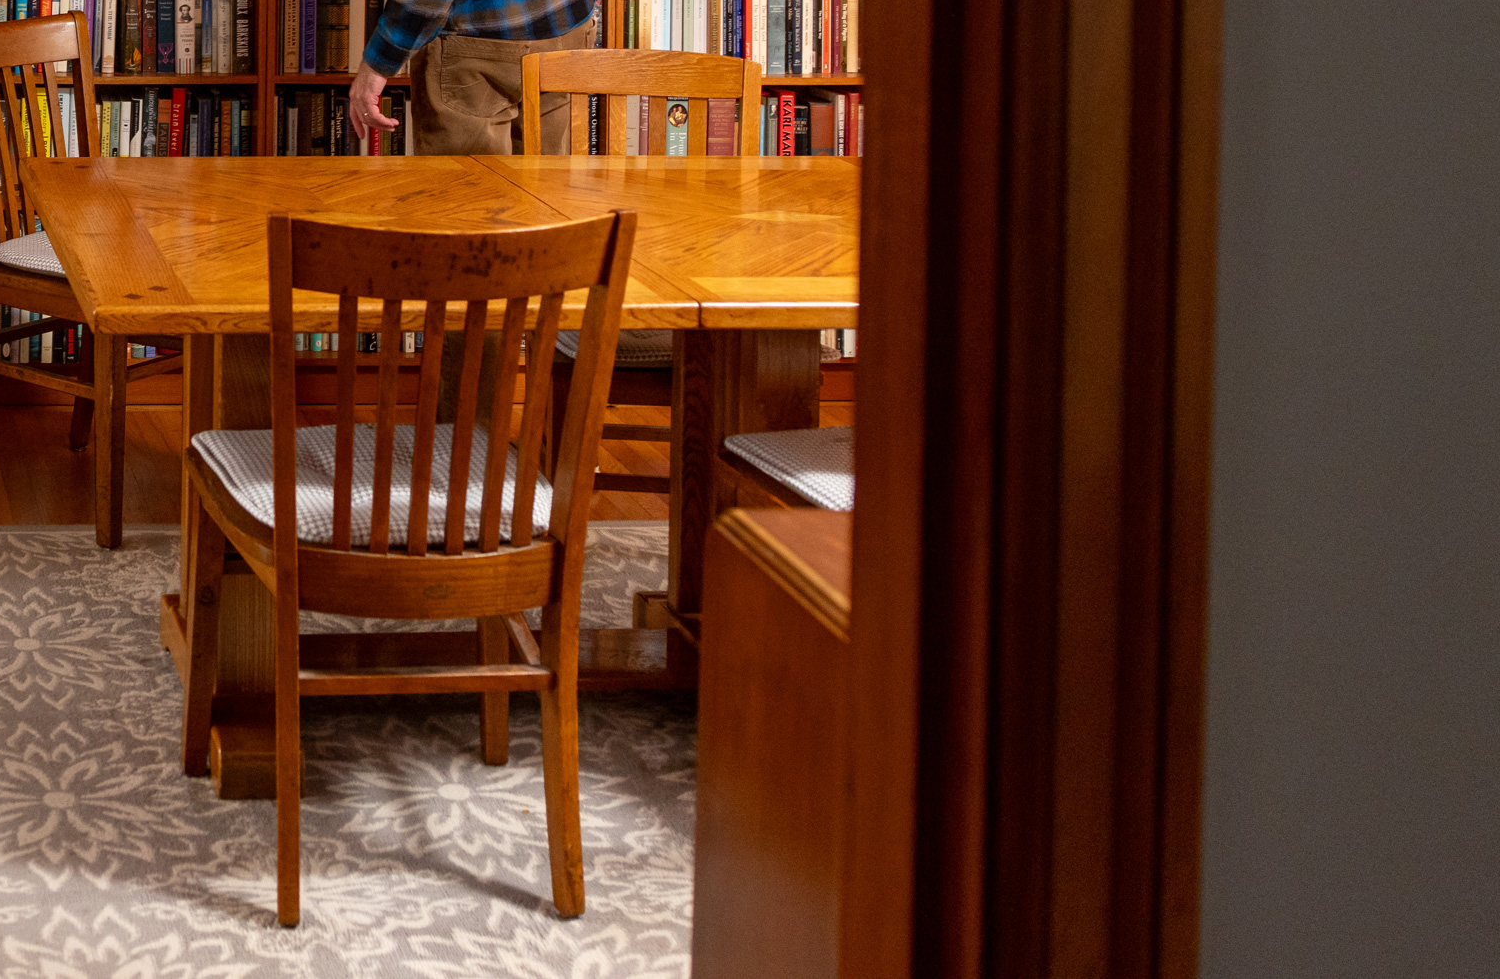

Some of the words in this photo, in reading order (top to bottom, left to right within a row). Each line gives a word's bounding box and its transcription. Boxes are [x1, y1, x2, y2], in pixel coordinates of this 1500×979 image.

[236, 19, 248, 57] BARKSKINS
[171, 103, 180, 127] brain
[336, 105, 344, 138] Shorts
[782, 99, 792, 128] KARL
[171, 129, 179, 151] fever
